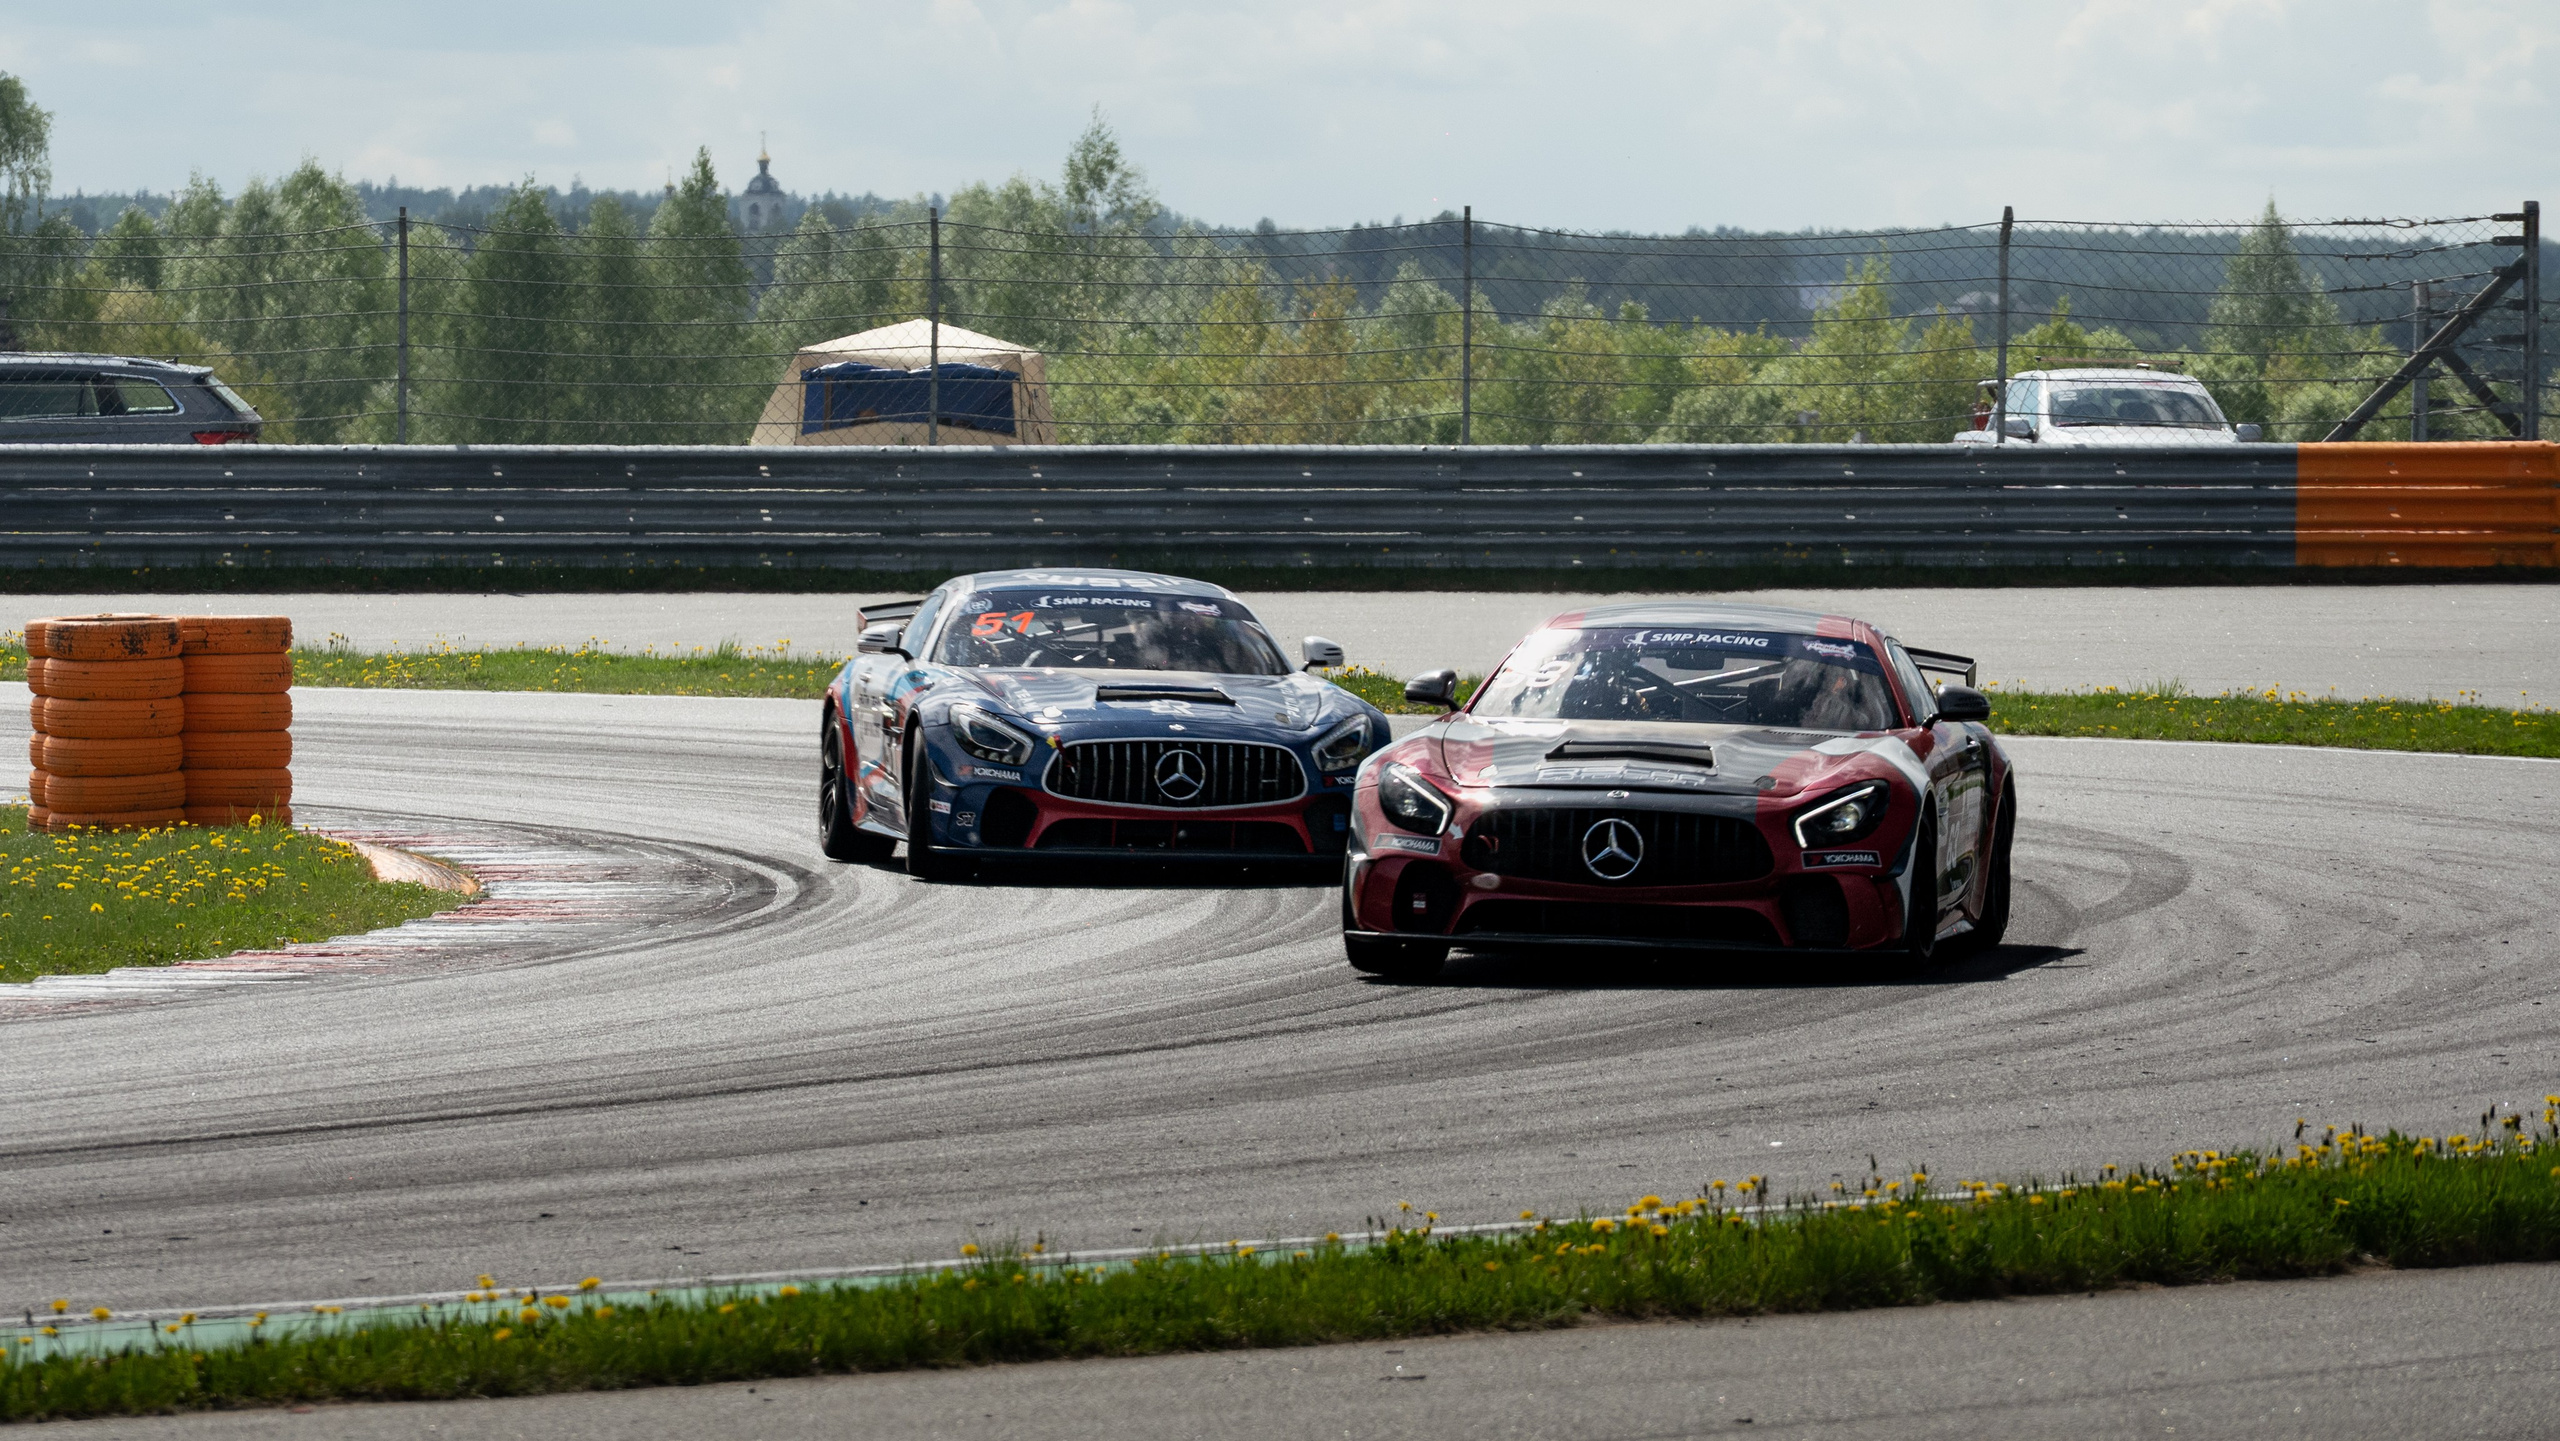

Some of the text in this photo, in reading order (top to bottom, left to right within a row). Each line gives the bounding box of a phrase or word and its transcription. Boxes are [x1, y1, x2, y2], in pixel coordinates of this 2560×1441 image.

[1052, 597, 1152, 608] SMP RACING
[971, 611, 1035, 637] 51
[1650, 633, 1770, 648] SMP RACING
[973, 766, 1021, 781] YOKOHAMA
[1390, 836, 1436, 851] YOKOHAMA
[1824, 853, 1876, 864] YOKOHAMA
